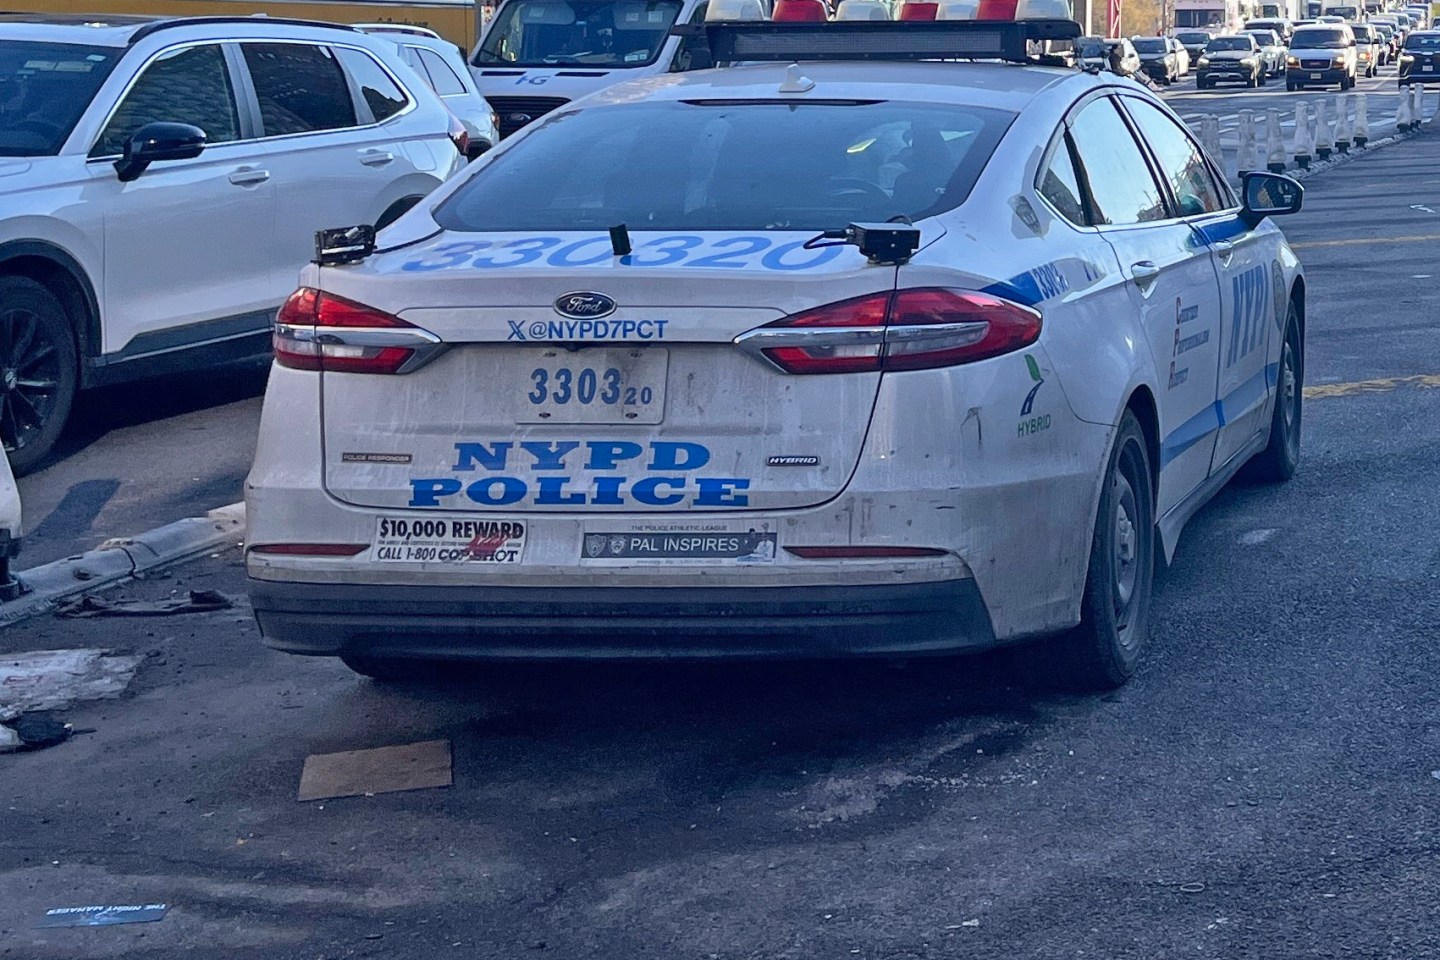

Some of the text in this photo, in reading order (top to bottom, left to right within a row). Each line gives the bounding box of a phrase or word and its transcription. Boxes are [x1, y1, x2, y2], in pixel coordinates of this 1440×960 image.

[566, 296, 603, 313] Ford
[528, 368, 652, 405] 3303 20
[1016, 413, 1052, 439] HYBRID
[451, 441, 711, 471] NYPD
[407, 475, 751, 506] POLICE
[380, 518, 524, 540] $10,000 REWARD
[378, 547, 402, 560] CALL
[406, 547, 437, 560] 1-800
[630, 538, 739, 552] PAL INSPIRES
[143, 903, 166, 911] THE
